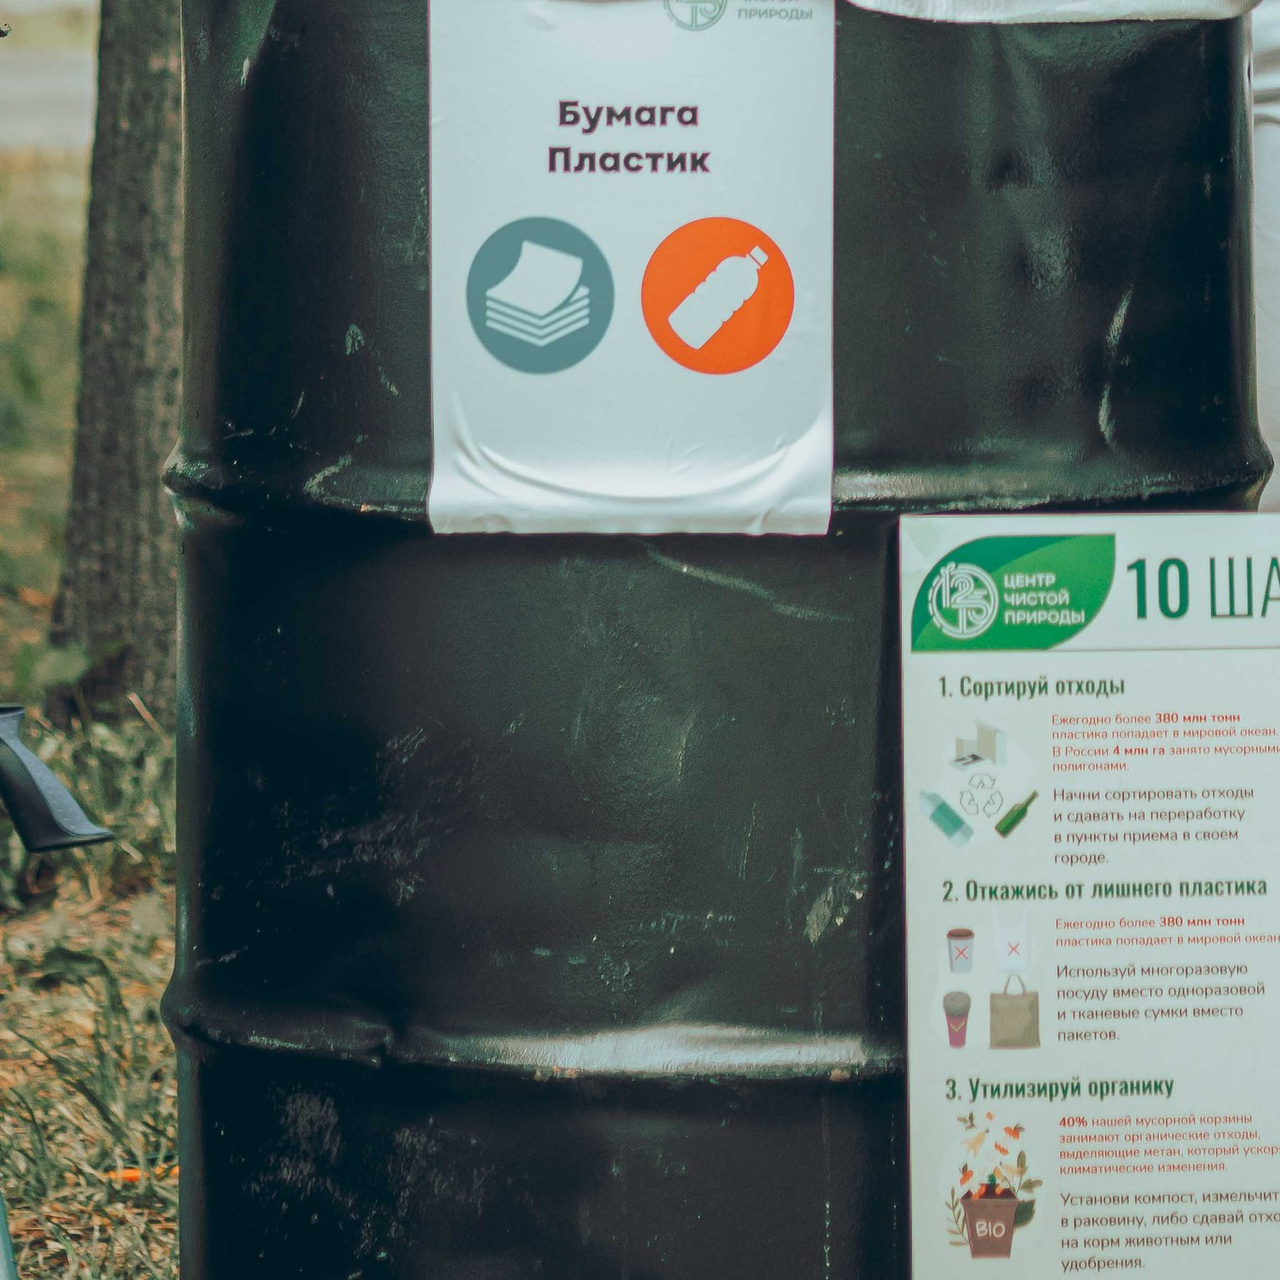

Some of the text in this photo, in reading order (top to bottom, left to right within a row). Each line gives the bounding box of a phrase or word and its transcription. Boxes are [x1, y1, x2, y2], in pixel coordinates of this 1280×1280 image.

[738, 8, 812, 21] ПРИРОДЫ
[558, 100, 699, 135] Бумага
[548, 146, 711, 173] Пластик
[1004, 573, 1056, 589] ЦЕНТР
[1126, 557, 1189, 620] 10
[1004, 588, 1069, 606] ЧИСТОЙ
[1004, 611, 1085, 625] ПРИРОДЫ
[939, 674, 1124, 701] 1. Сортируй отходы
[1051, 712, 1240, 726] Ежегодно более 380 млн тонн
[1052, 730, 1108, 740] пластика
[1111, 730, 1169, 740] попадает
[1172, 729, 1179, 738] в
[1183, 726, 1236, 739] мировой
[1052, 746, 1061, 757] В
[1065, 745, 1108, 757] России
[1112, 745, 1120, 755] 4
[1124, 747, 1148, 755] млн
[1152, 746, 1165, 755] га
[1169, 746, 1210, 754] занято
[1053, 787, 1253, 803] Начни сортировать отходы
[1053, 806, 1245, 824] и сдавать на переработку
[1054, 830, 1238, 846] в пункты приема в своем
[1054, 853, 1108, 867] городе.
[942, 878, 1267, 902] 2. Откажись от лишнего пластика
[1056, 963, 1248, 980] Используй многоразовую
[1056, 981, 1265, 1002] посуду вместо одноразовой
[1057, 1006, 1243, 1021] и тканевые сумки вместо
[1057, 1030, 1119, 1041] пакетов.
[945, 1075, 1174, 1103] 3. Утилизируй органику
[1060, 1191, 1129, 1206] Установи
[1134, 1193, 1197, 1205] компост,
[1060, 1217, 1068, 1227] в
[1073, 1215, 1146, 1230] раковину,
[1151, 1211, 1188, 1225] либо
[1192, 1209, 1243, 1226] сдавай
[976, 1221, 1006, 1238] BIO
[1061, 1234, 1232, 1251] на корм животным или
[1060, 1255, 1144, 1273] удобрения.
